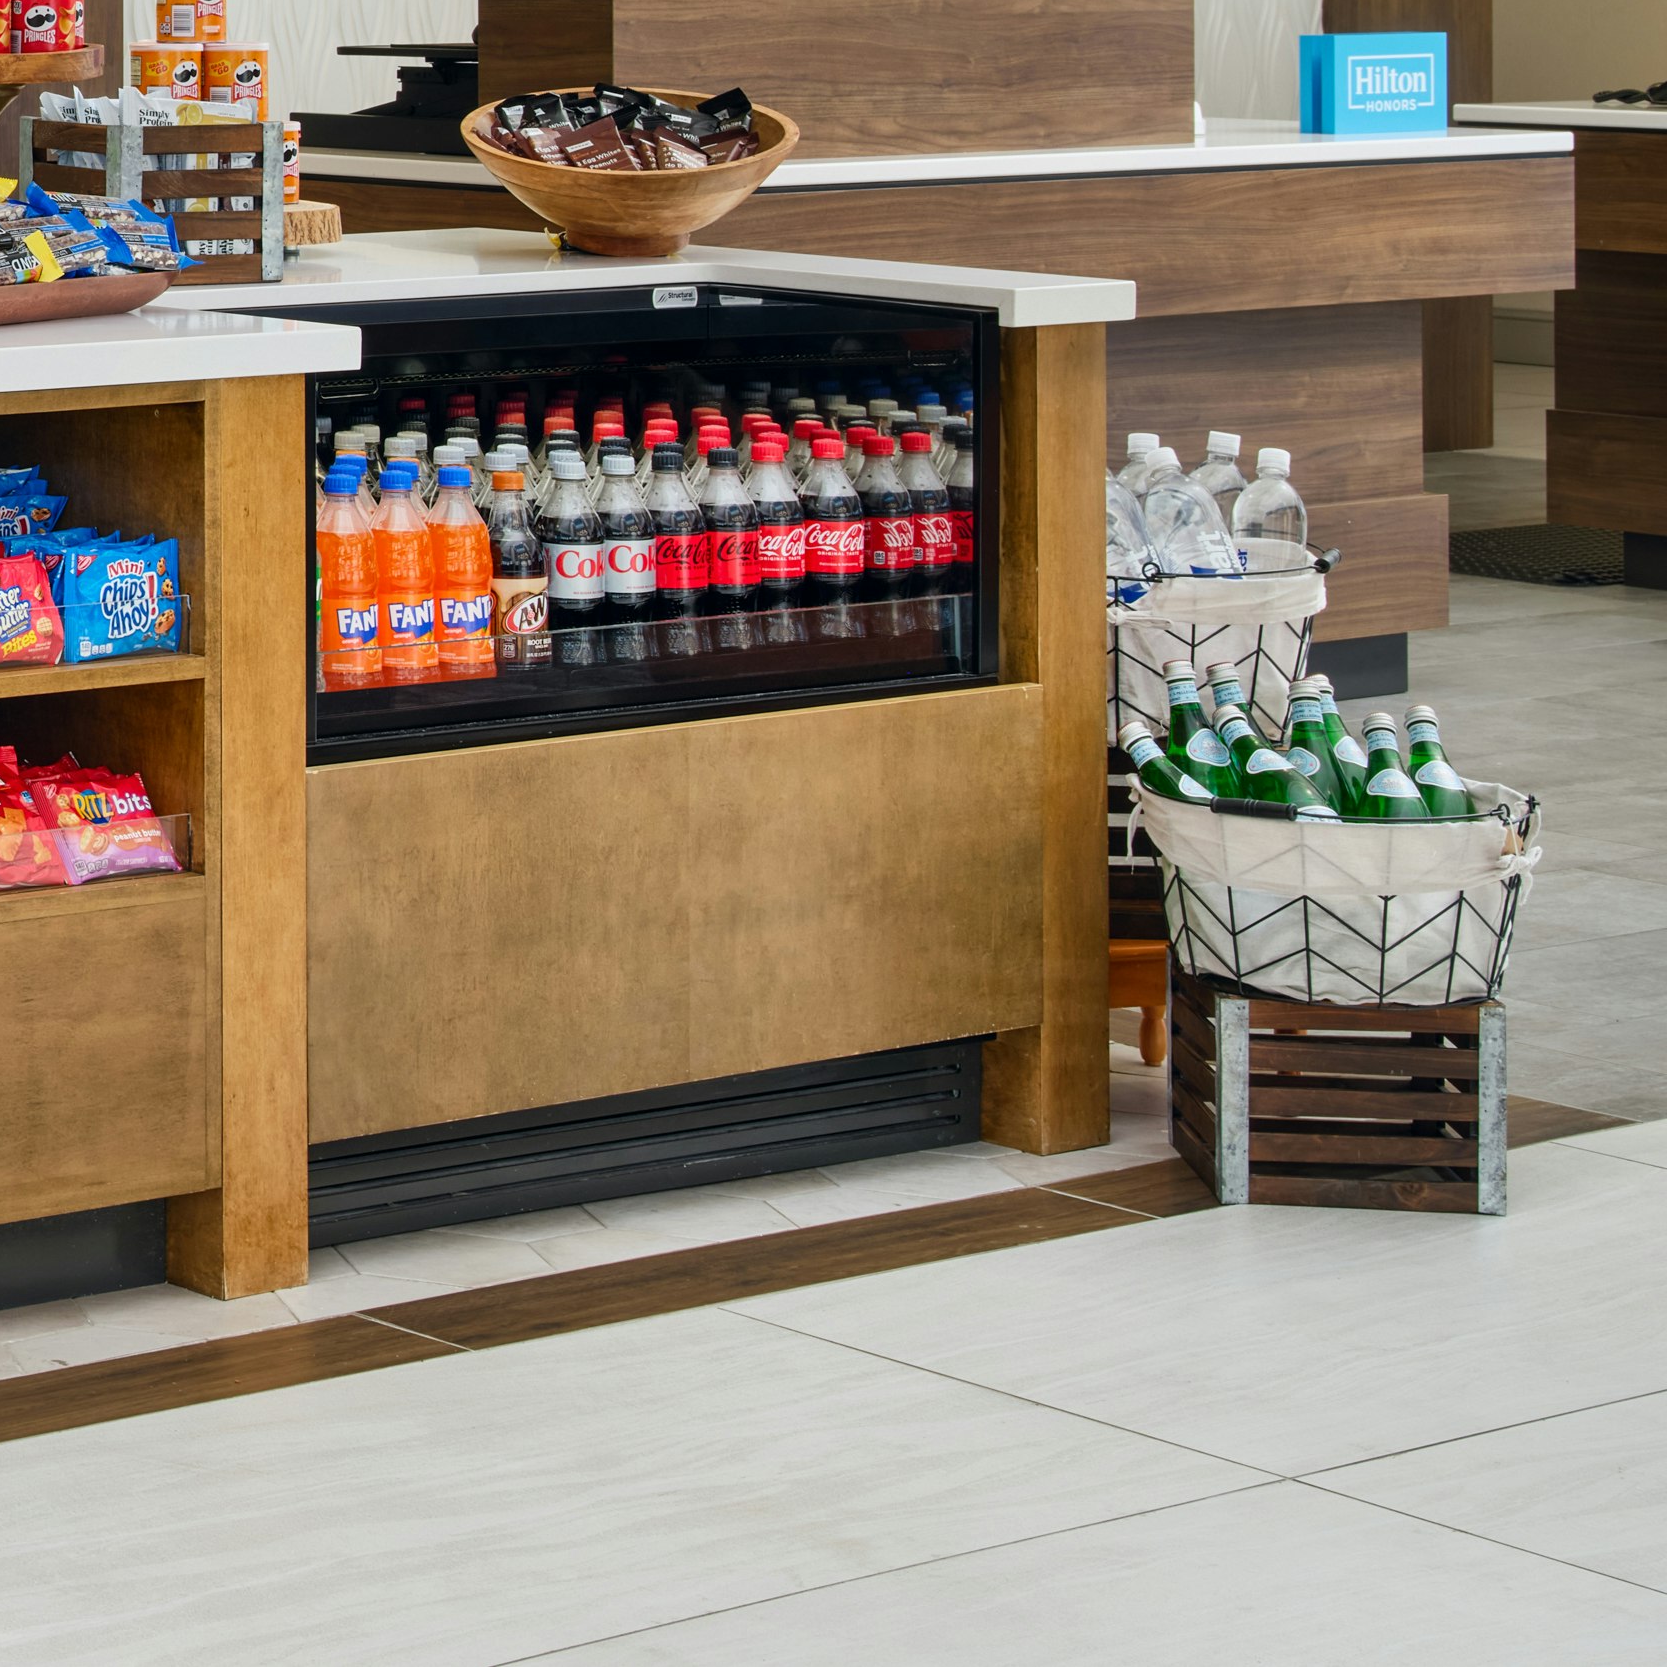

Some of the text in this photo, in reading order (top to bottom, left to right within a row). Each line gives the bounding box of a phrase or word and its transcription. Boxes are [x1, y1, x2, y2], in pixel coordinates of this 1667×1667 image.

[1355, 66, 1427, 95] Hilton
[1366, 99, 1416, 112] HONORS
[139, 108, 170, 119] Simply
[139, 117, 173, 126] Protein
[12, 256, 40, 271] KIND
[101, 579, 147, 613] Chips
[2, 631, 38, 658] Bites
[73, 792, 152, 820] RITZ bits
[114, 831, 141, 841] peanut
